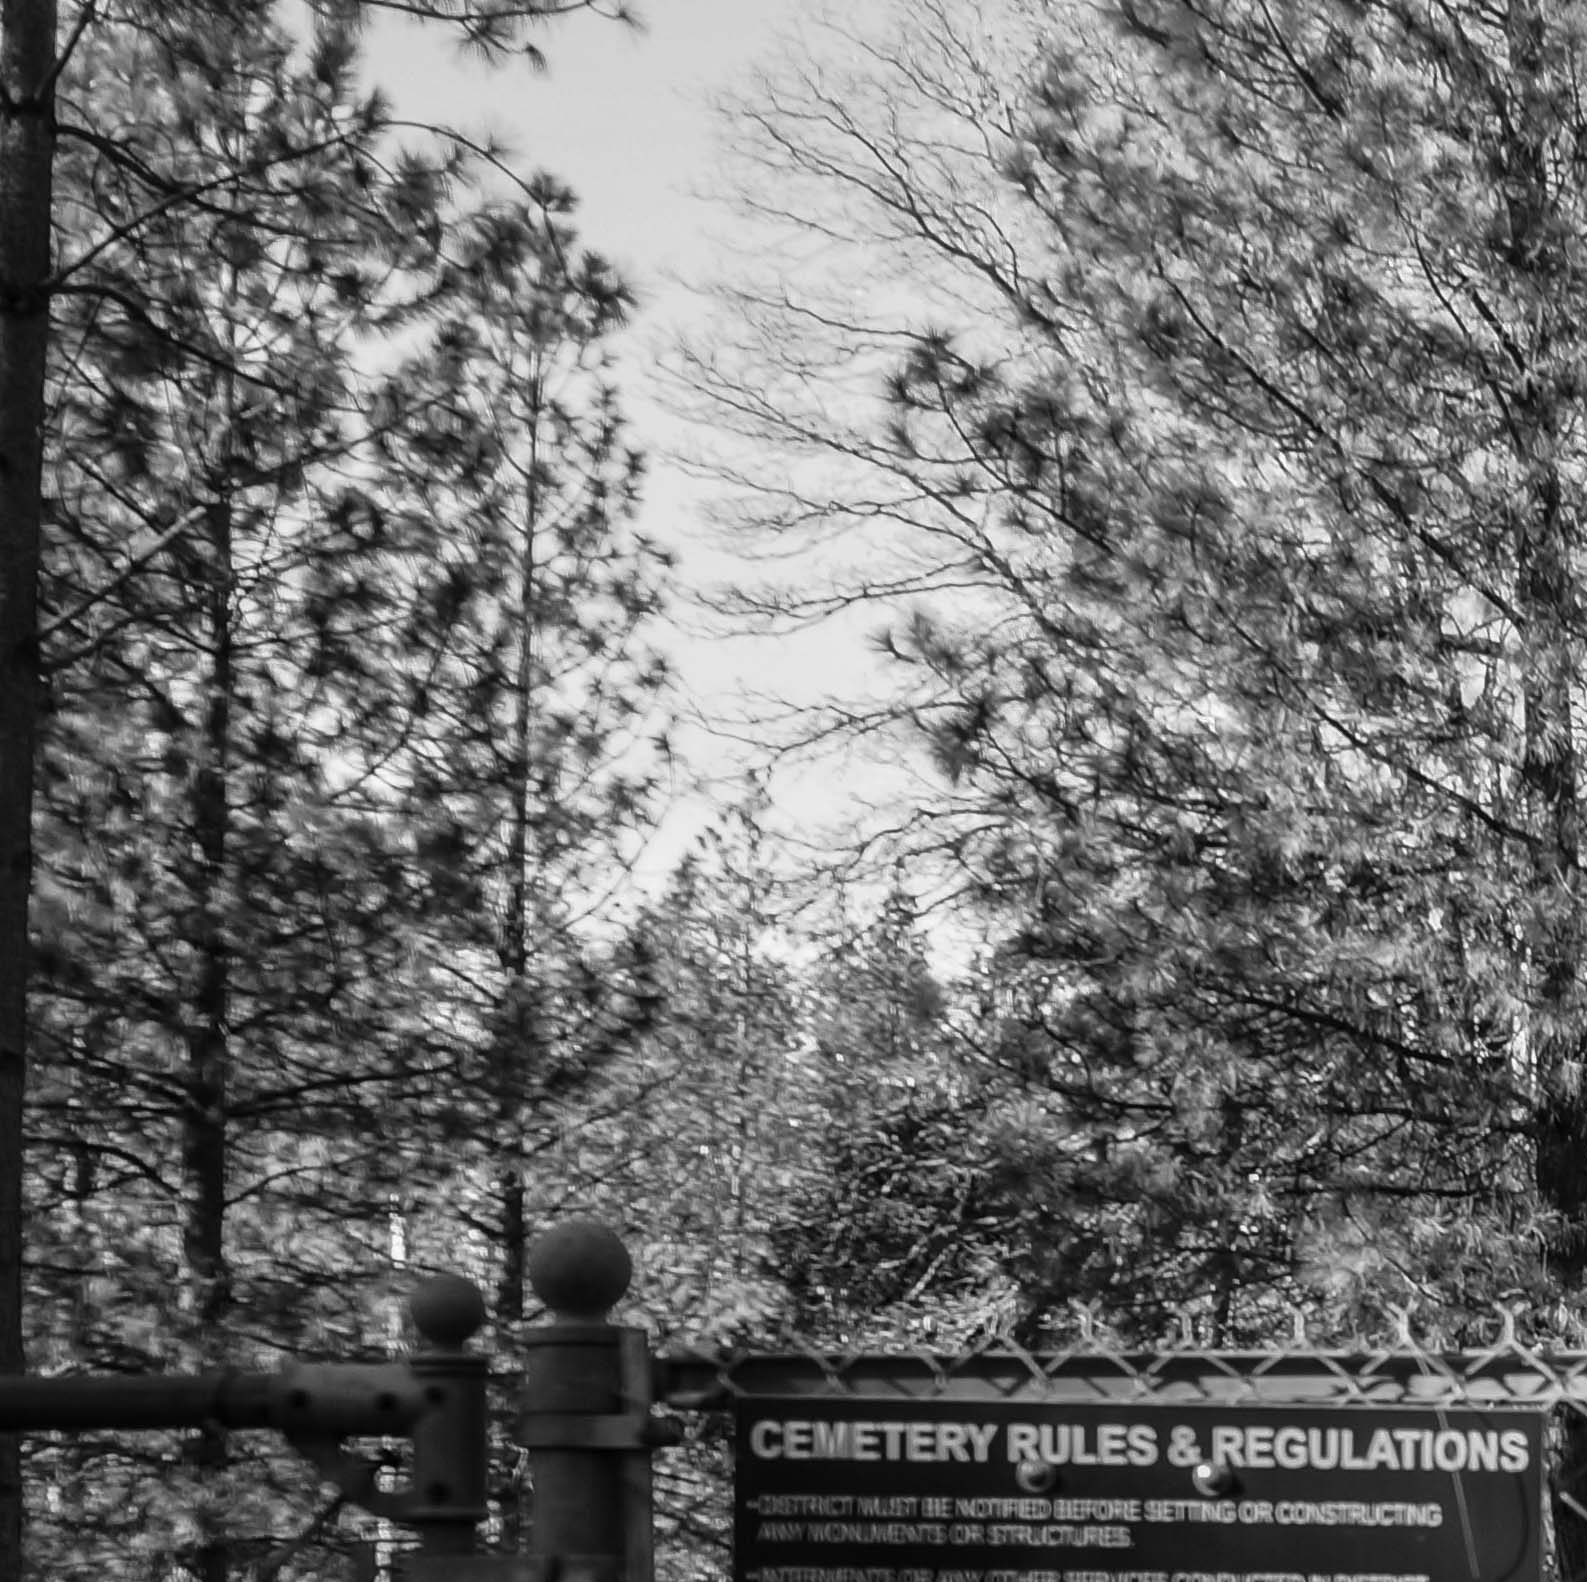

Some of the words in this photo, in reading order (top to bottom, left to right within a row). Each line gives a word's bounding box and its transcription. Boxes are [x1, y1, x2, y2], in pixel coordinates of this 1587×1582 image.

[750, 1420, 998, 1463] CEMETERY
[1006, 1423, 1160, 1467] RULES
[1167, 1426, 1204, 1468] &
[1211, 1428, 1530, 1473] REGULATIONS
[856, 1495, 918, 1517] MUST
[921, 1496, 953, 1518] BE
[955, 1497, 1051, 1519] NOTIFIED
[1053, 1498, 1143, 1521] BEFORE
[1144, 1500, 1238, 1522] SETTING
[1238, 1500, 1274, 1523] OR
[1275, 1502, 1444, 1525] CONSTRUCTING
[756, 1522, 807, 1541] ANY
[806, 1522, 947, 1543] MONUMENTS
[950, 1523, 984, 1545] OR
